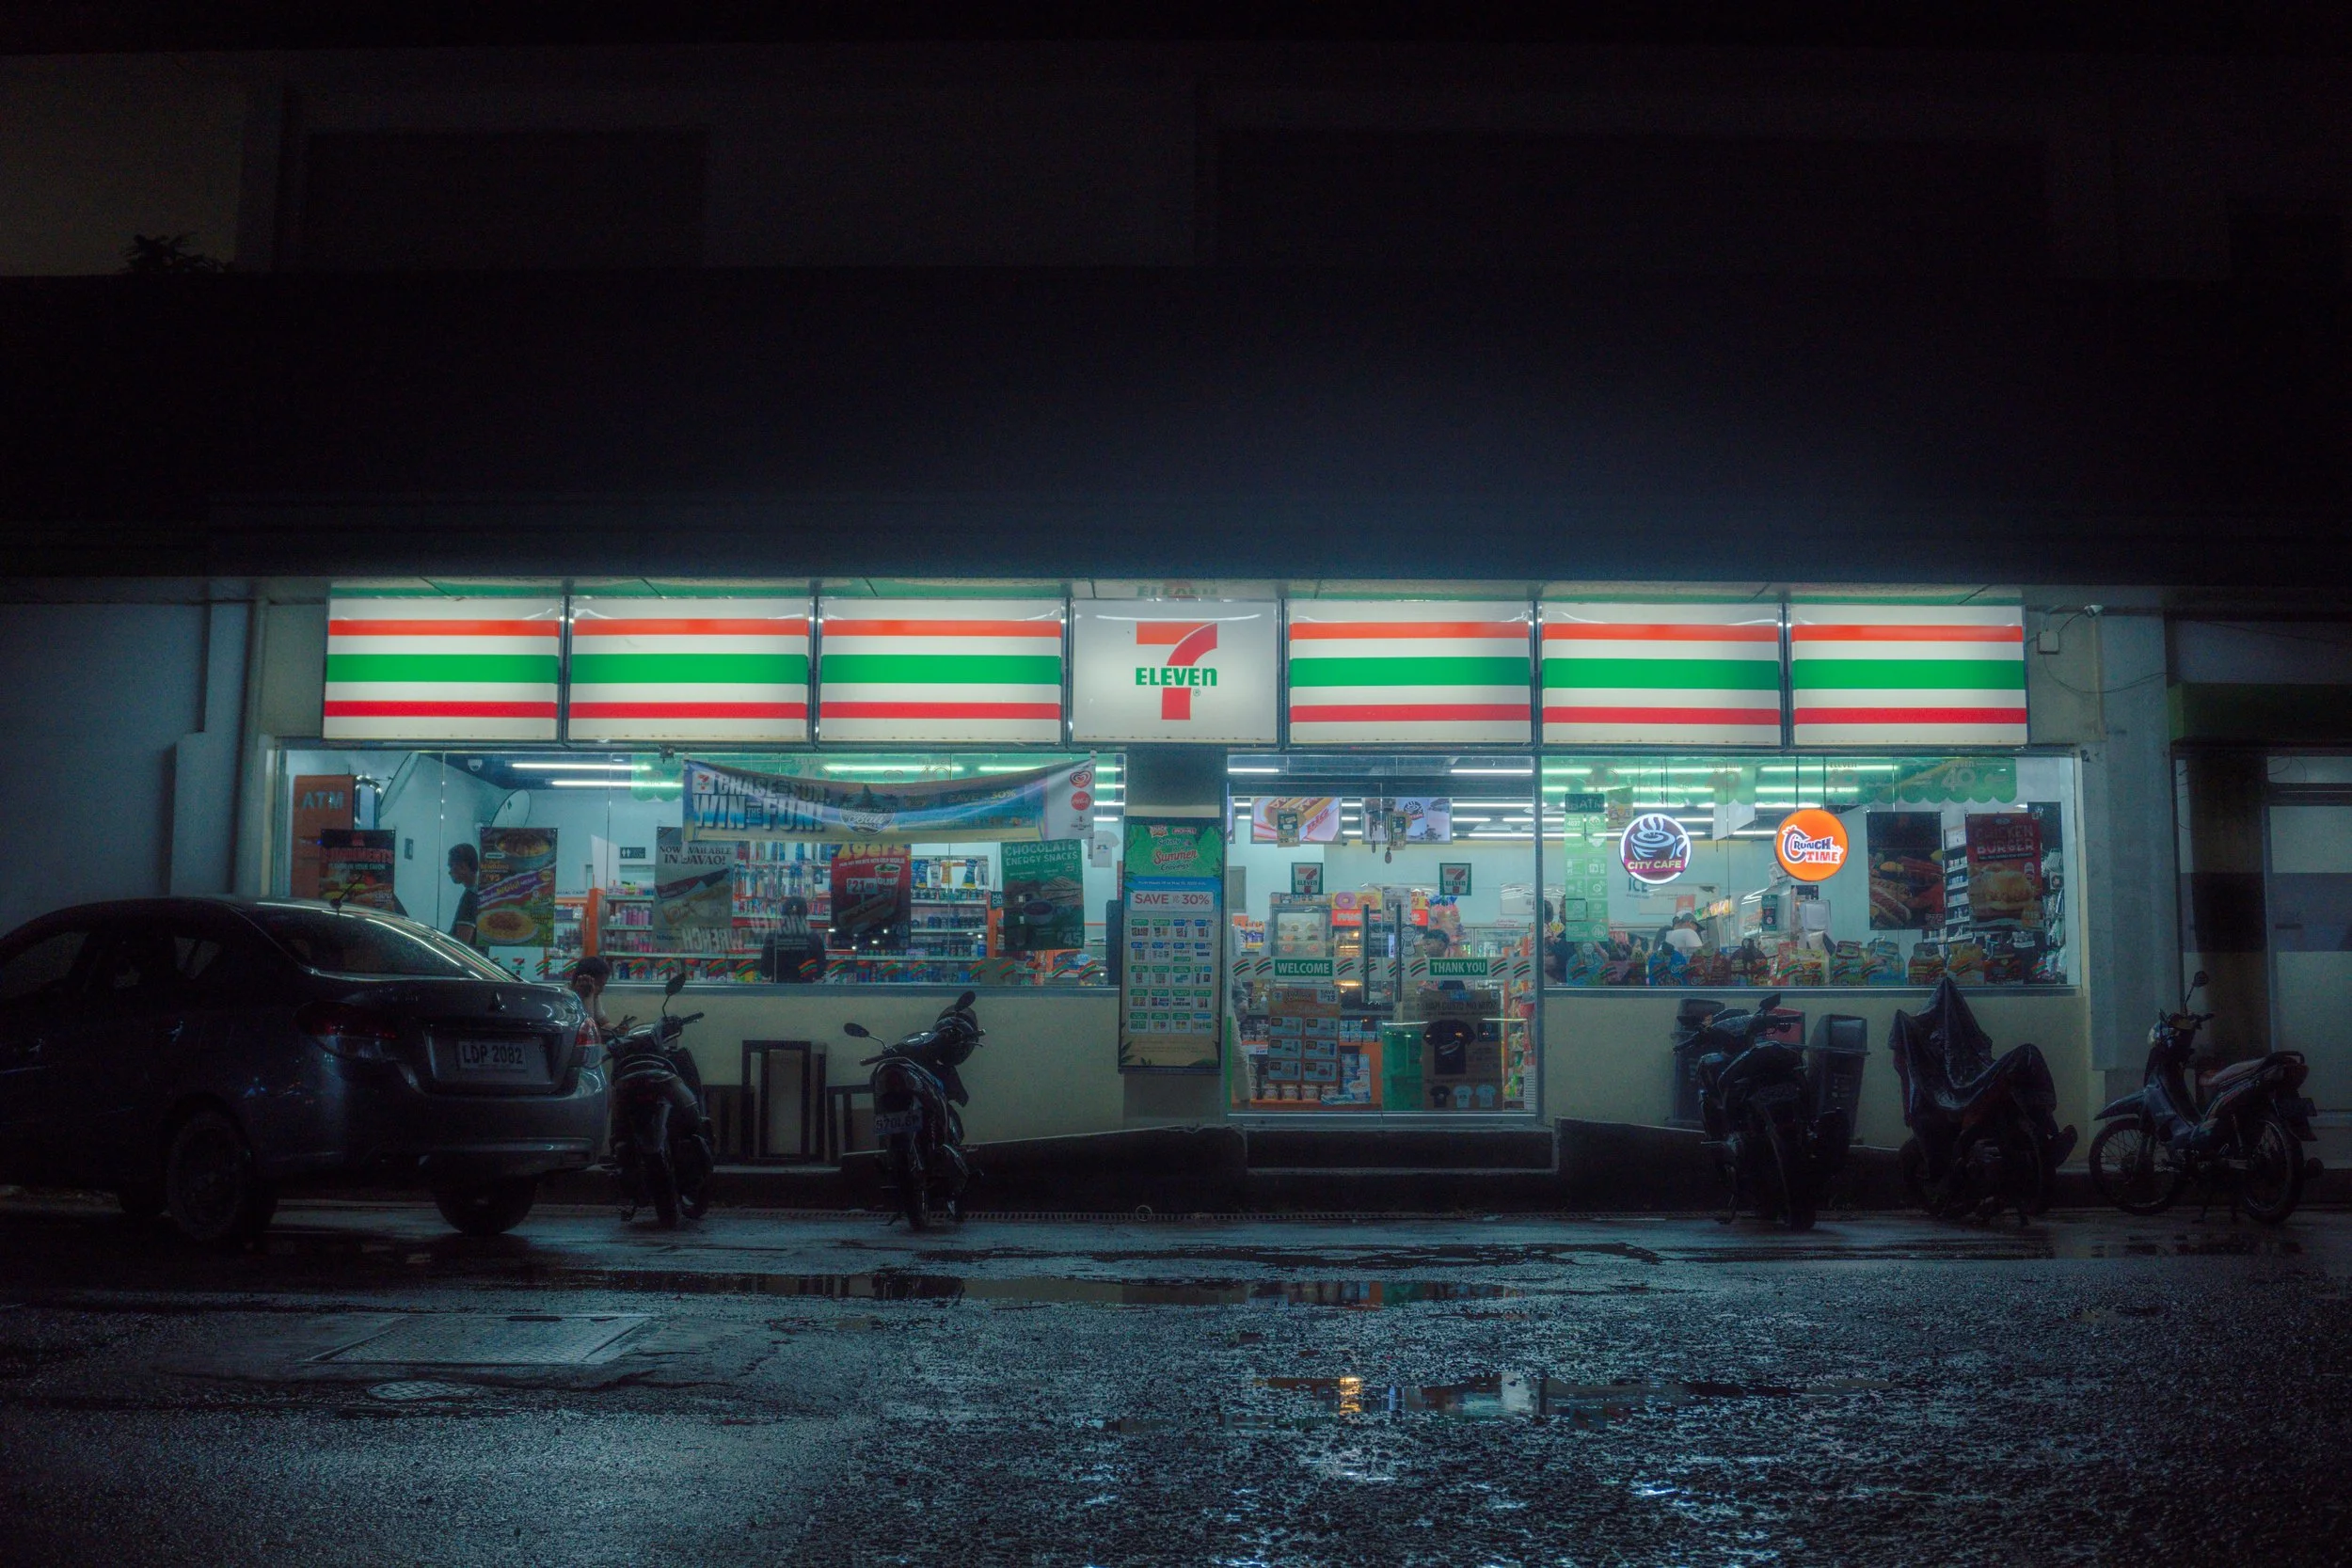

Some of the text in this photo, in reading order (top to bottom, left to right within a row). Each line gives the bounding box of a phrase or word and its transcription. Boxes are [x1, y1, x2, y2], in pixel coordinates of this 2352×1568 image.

[1136, 622, 1217, 720] 7
[1136, 667, 1217, 686] ELEVEN
[302, 790, 344, 810] ATM
[692, 795, 746, 829] WIN
[746, 807, 761, 817] THE
[1005, 839, 1076, 857] CHOCOLATE
[1978, 837, 2034, 854] BURGER
[664, 854, 726, 865] IN DAVAO!
[1006, 851, 1078, 866] ENERGY SNACKS
[1153, 848, 1199, 865] Summer
[1627, 860, 1682, 870] CITY CAFE
[1806, 851, 1838, 862] TIME
[1297, 867, 1318, 894] 7
[1446, 867, 1466, 894] 7
[1629, 877, 1648, 893] ICE
[1135, 894, 1168, 904] SAVE
[1182, 894, 1210, 905] 30%
[1277, 962, 1330, 974] WELCOME
[1432, 962, 1486, 974] THANK YOU
[463, 1044, 524, 1064] LDP 2082
